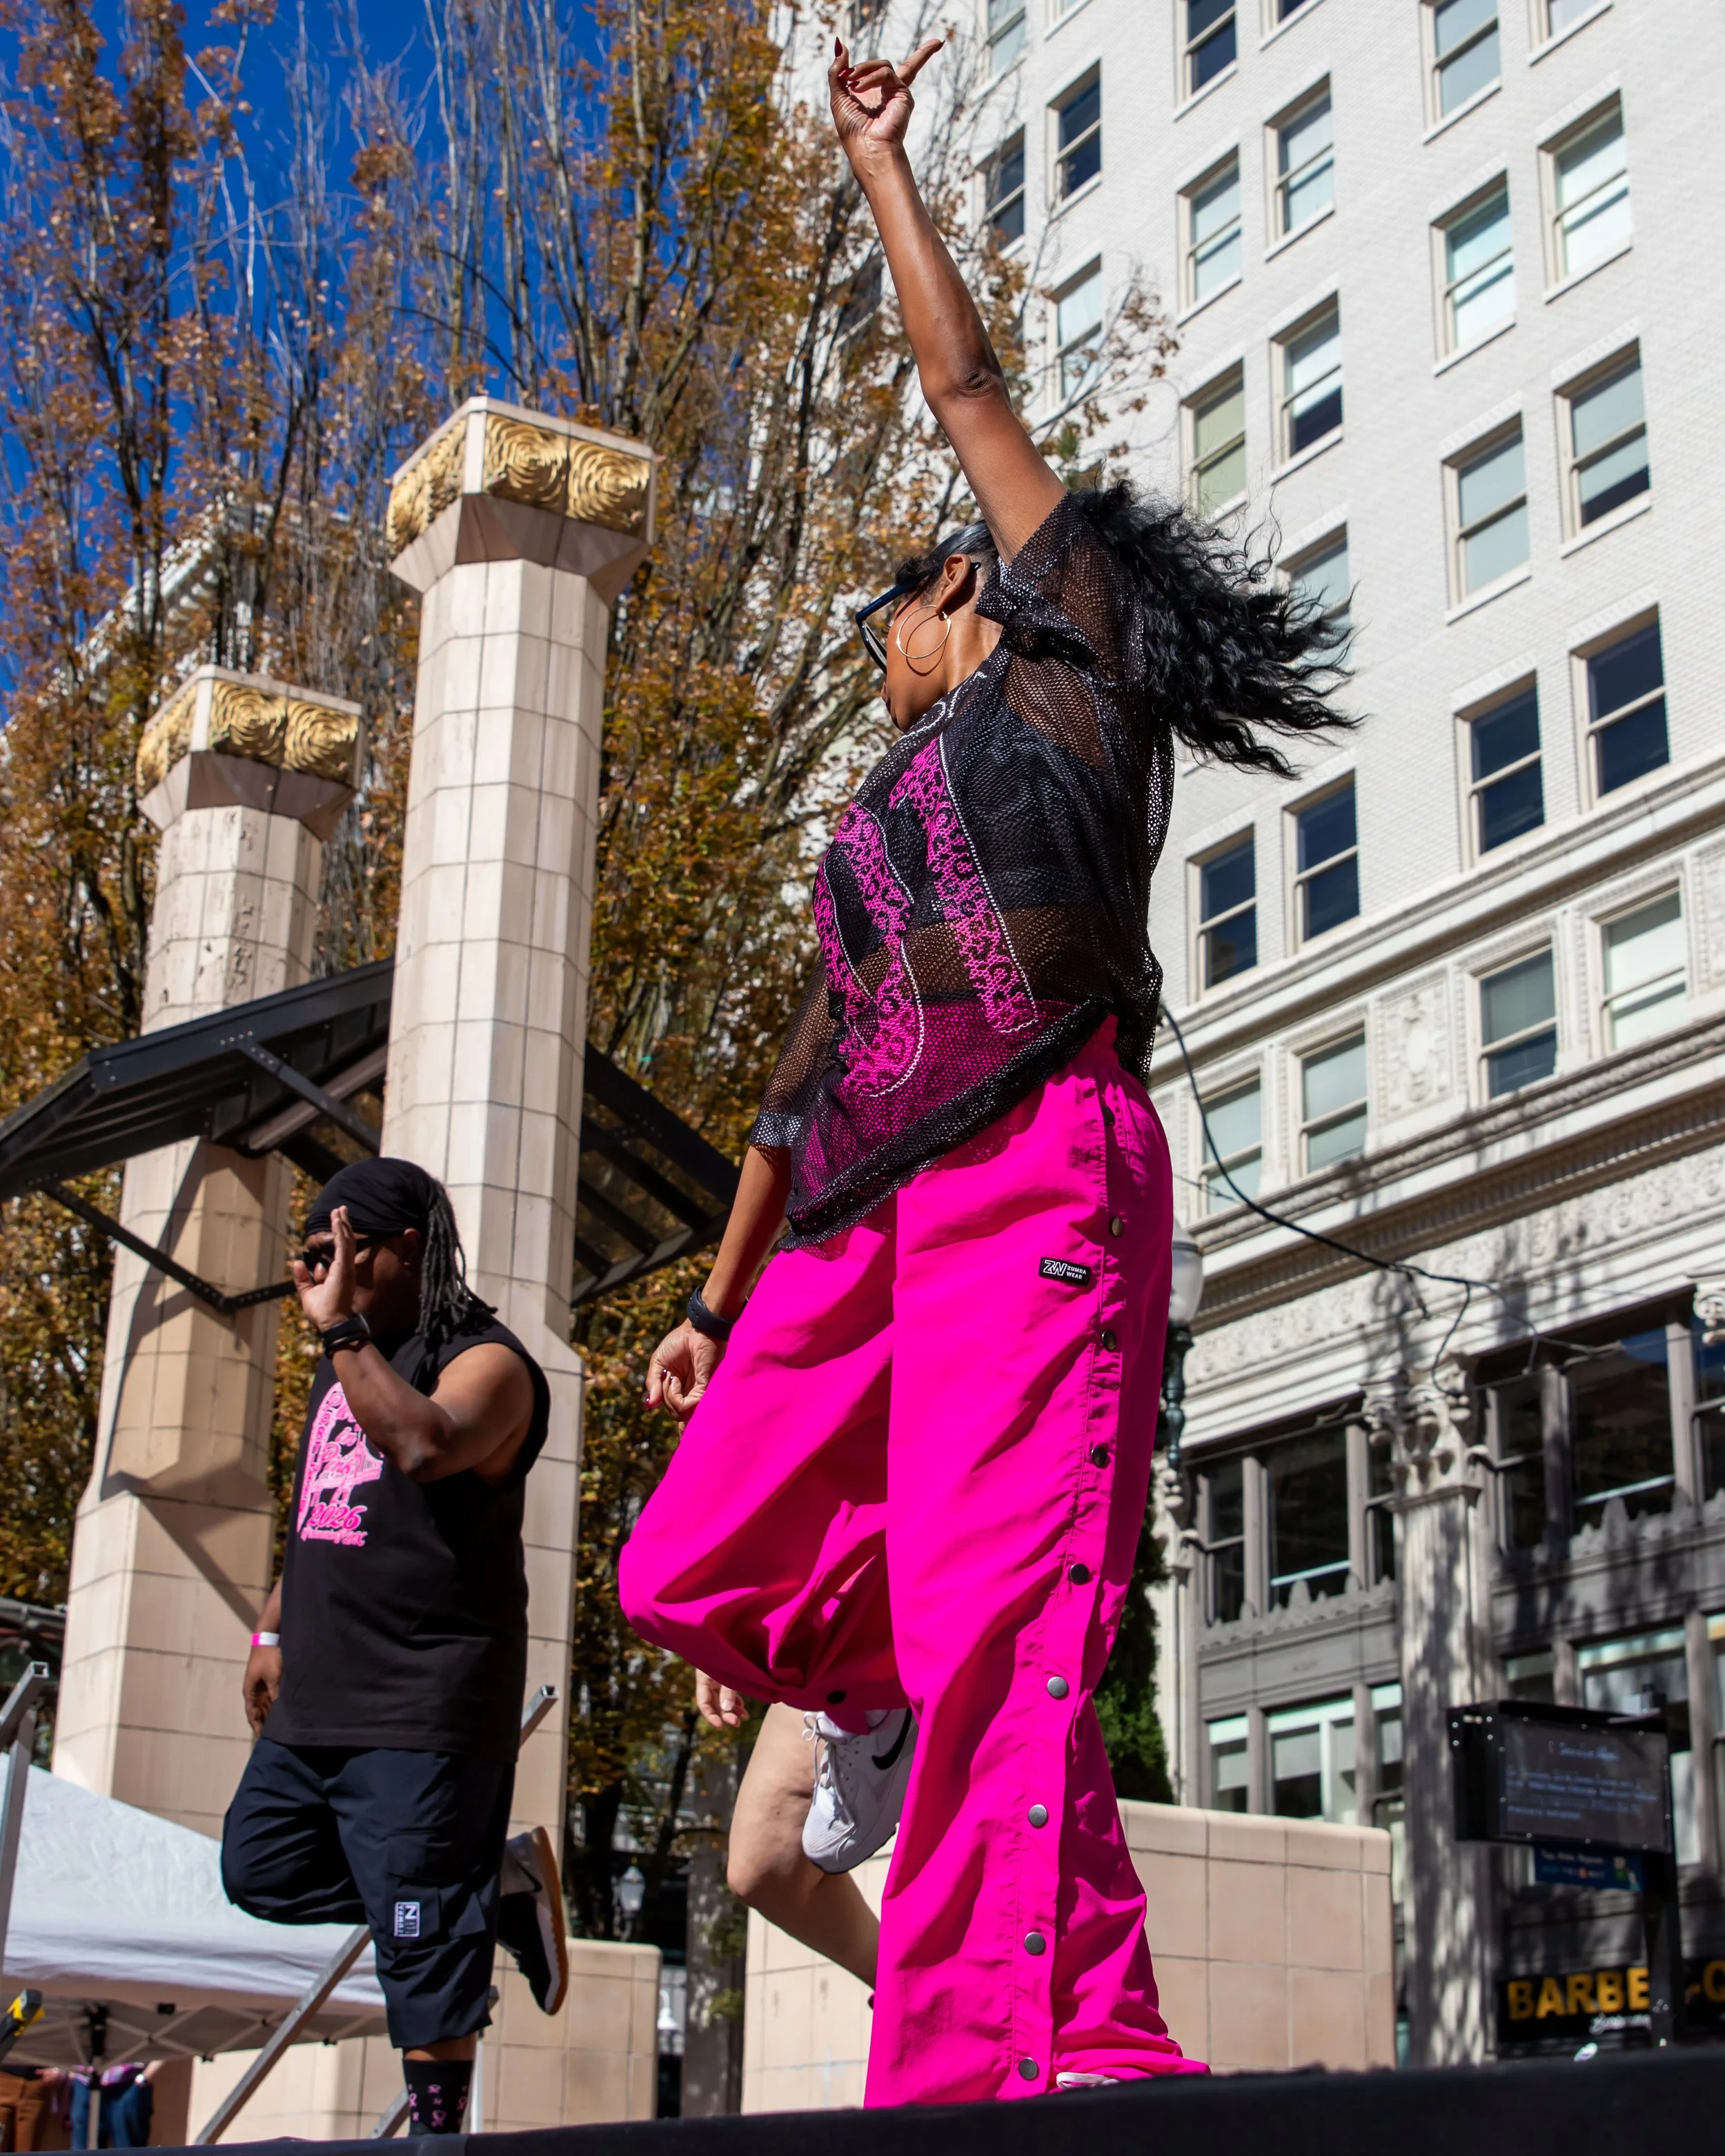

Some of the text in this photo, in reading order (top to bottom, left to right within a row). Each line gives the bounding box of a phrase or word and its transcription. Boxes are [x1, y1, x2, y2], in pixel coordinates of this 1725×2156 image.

[1043, 1259, 1067, 1276] ZW
[1067, 1265, 1087, 1275] ZUMBA
[1066, 1272, 1083, 1280] WEAR
[306, 1501, 368, 1531] 2026
[404, 1905, 417, 1920] Z
[1508, 1966, 1650, 2021] BARBE
